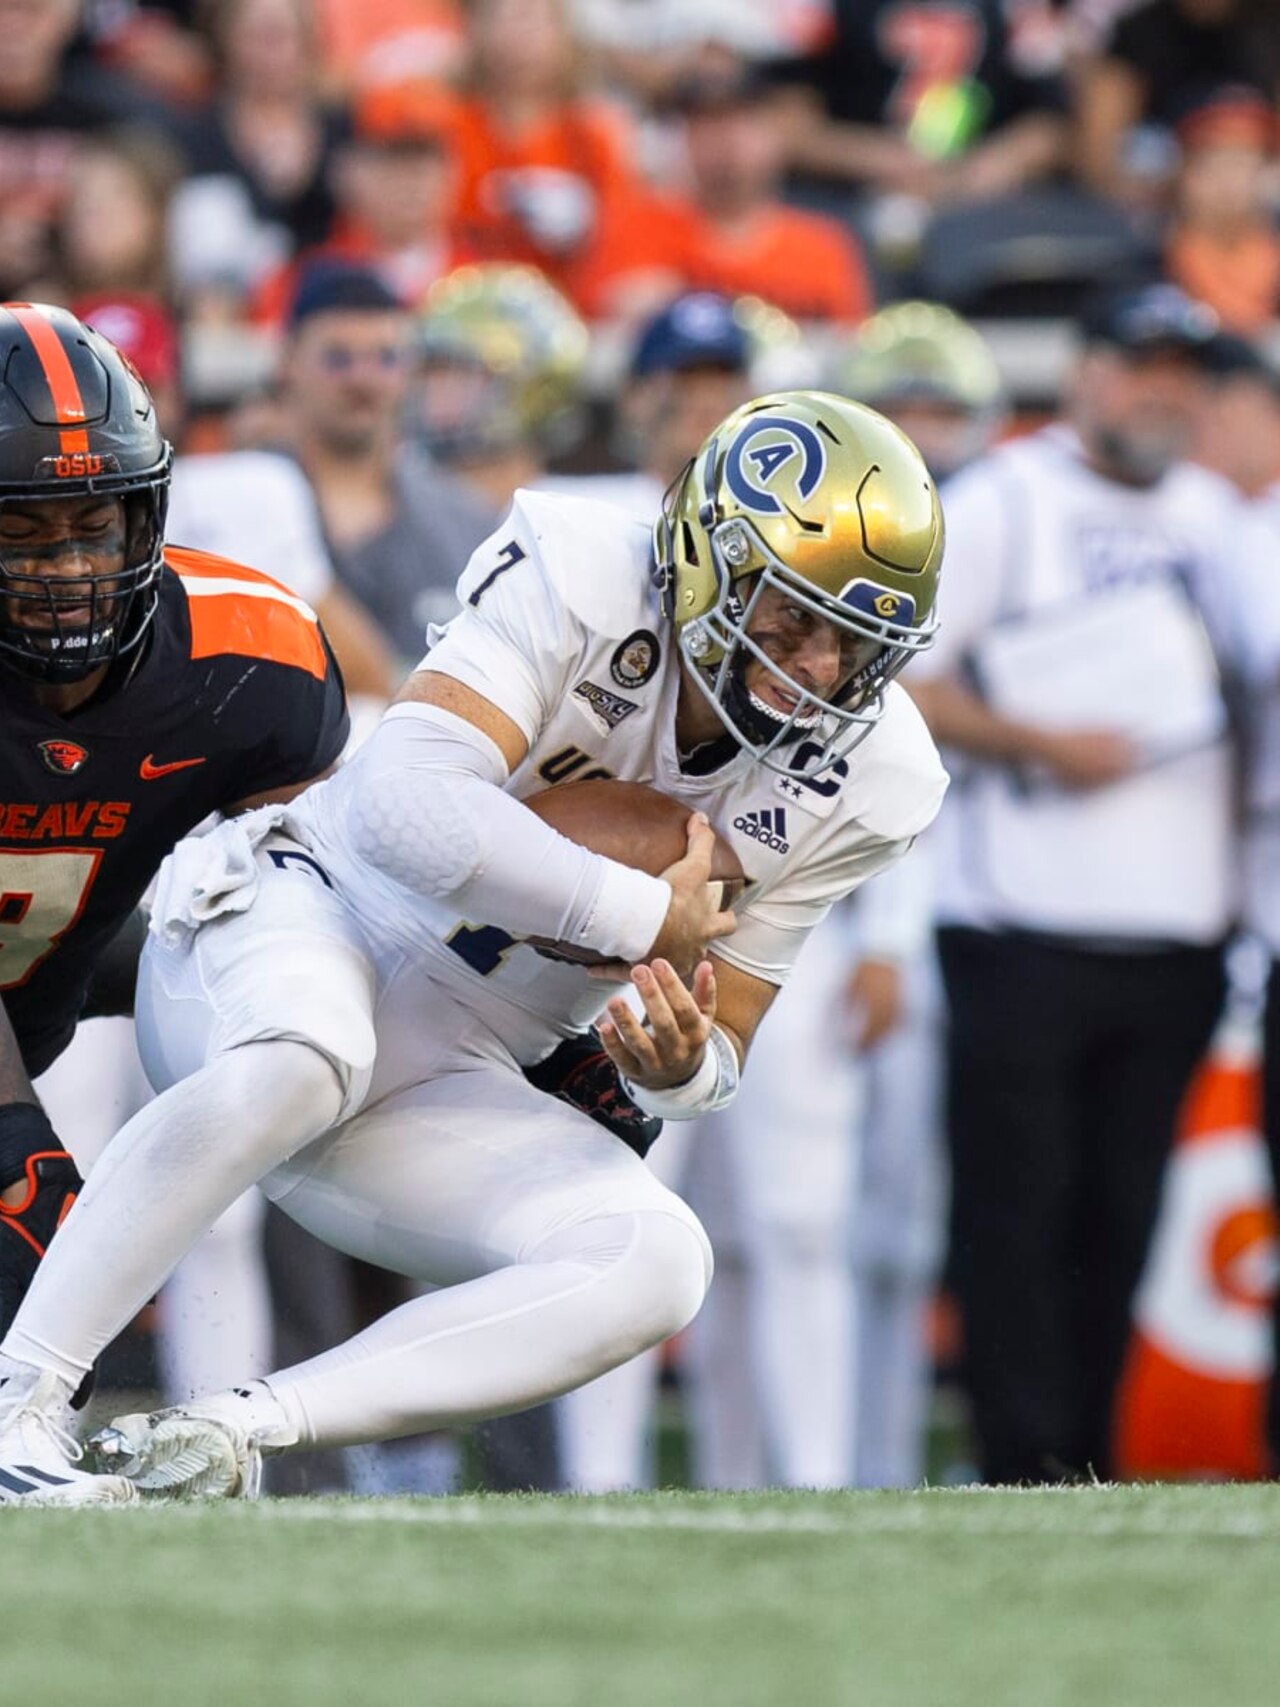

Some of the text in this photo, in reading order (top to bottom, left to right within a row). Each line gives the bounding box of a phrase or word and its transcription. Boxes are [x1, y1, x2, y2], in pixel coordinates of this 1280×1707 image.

[55, 455, 102, 478] OSU
[468, 540, 526, 607] 7
[789, 741, 849, 798] C
[733, 817, 790, 855] adidas
